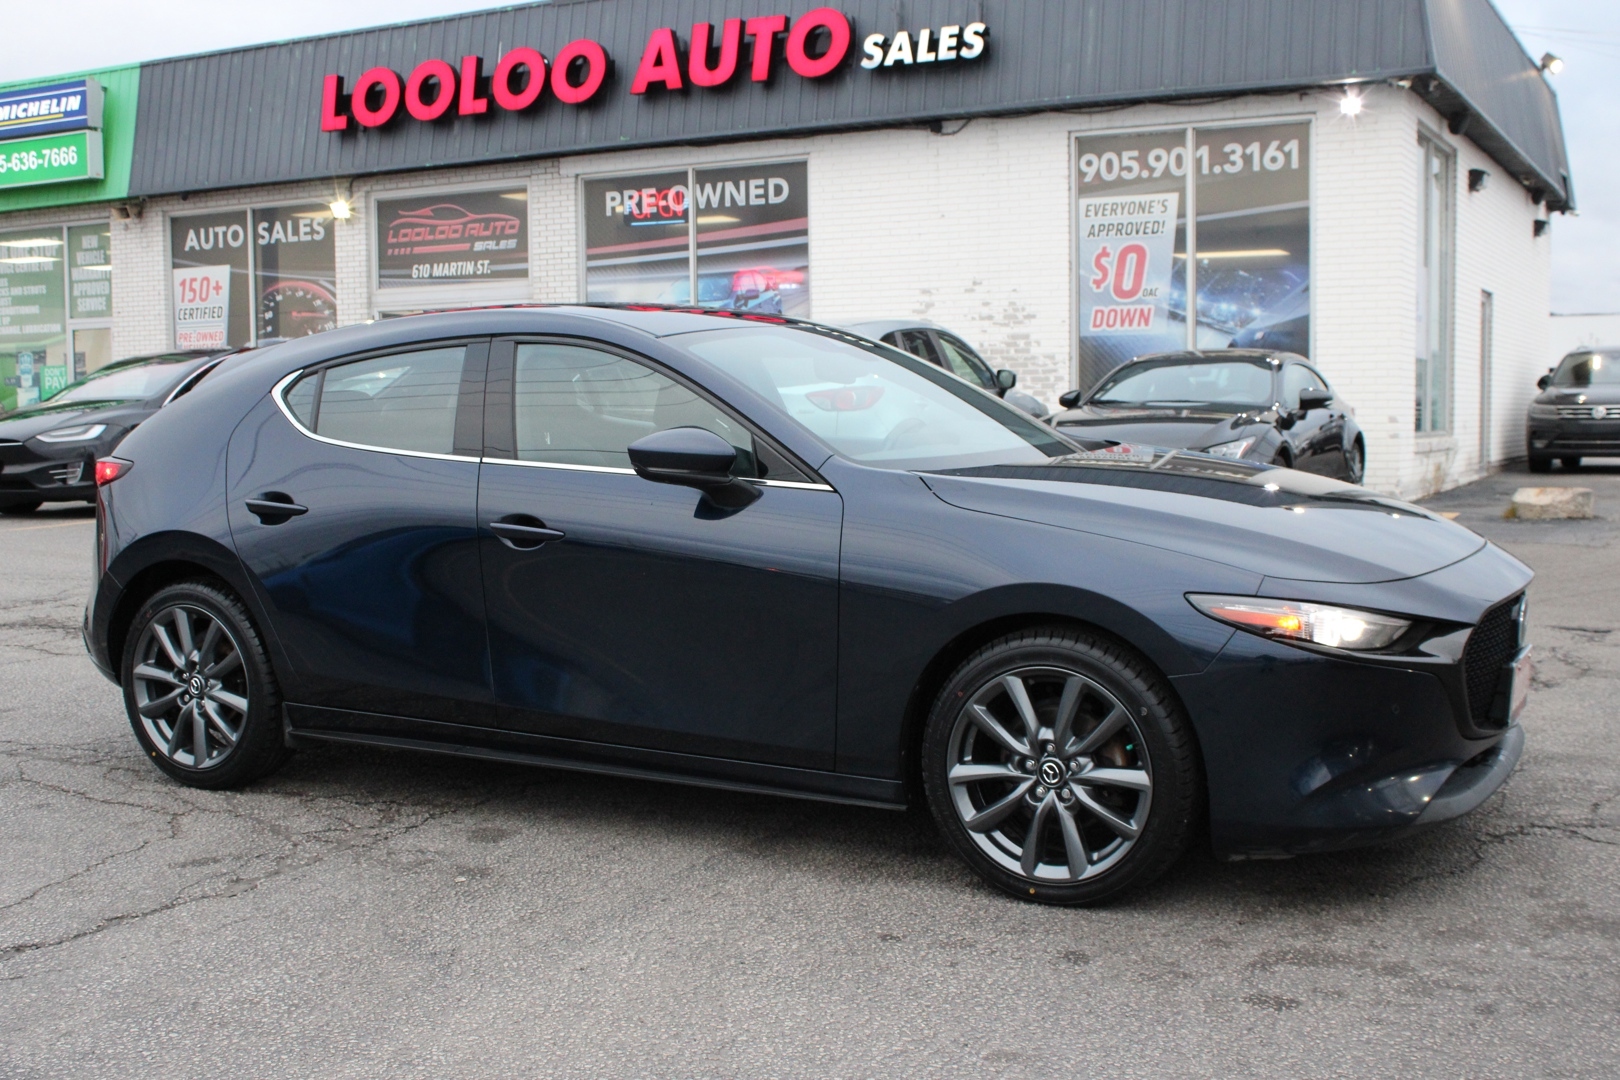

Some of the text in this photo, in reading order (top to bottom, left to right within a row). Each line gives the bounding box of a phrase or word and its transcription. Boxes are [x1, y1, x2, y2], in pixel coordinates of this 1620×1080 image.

[859, 22, 986, 69] SALES
[321, 7, 851, 132] LOOLOO AUTO
[1079, 139, 1299, 182] 905.901.3161
[605, 177, 789, 217] PRE-OWNED
[1085, 199, 1168, 219] EVERYONE'S
[184, 218, 326, 251] AUTO SALES
[387, 220, 521, 244] LOOLOO AUTO
[1087, 220, 1165, 239] APPROVED!
[473, 239, 518, 252] SALES
[412, 260, 491, 278] 610 MARTIN ST.
[1092, 243, 1148, 300] $0
[179, 276, 223, 304] 150+
[178, 306, 223, 321] CERTIFIED
[1092, 307, 1152, 329] DOWN
[45, 376, 66, 389] PAY
